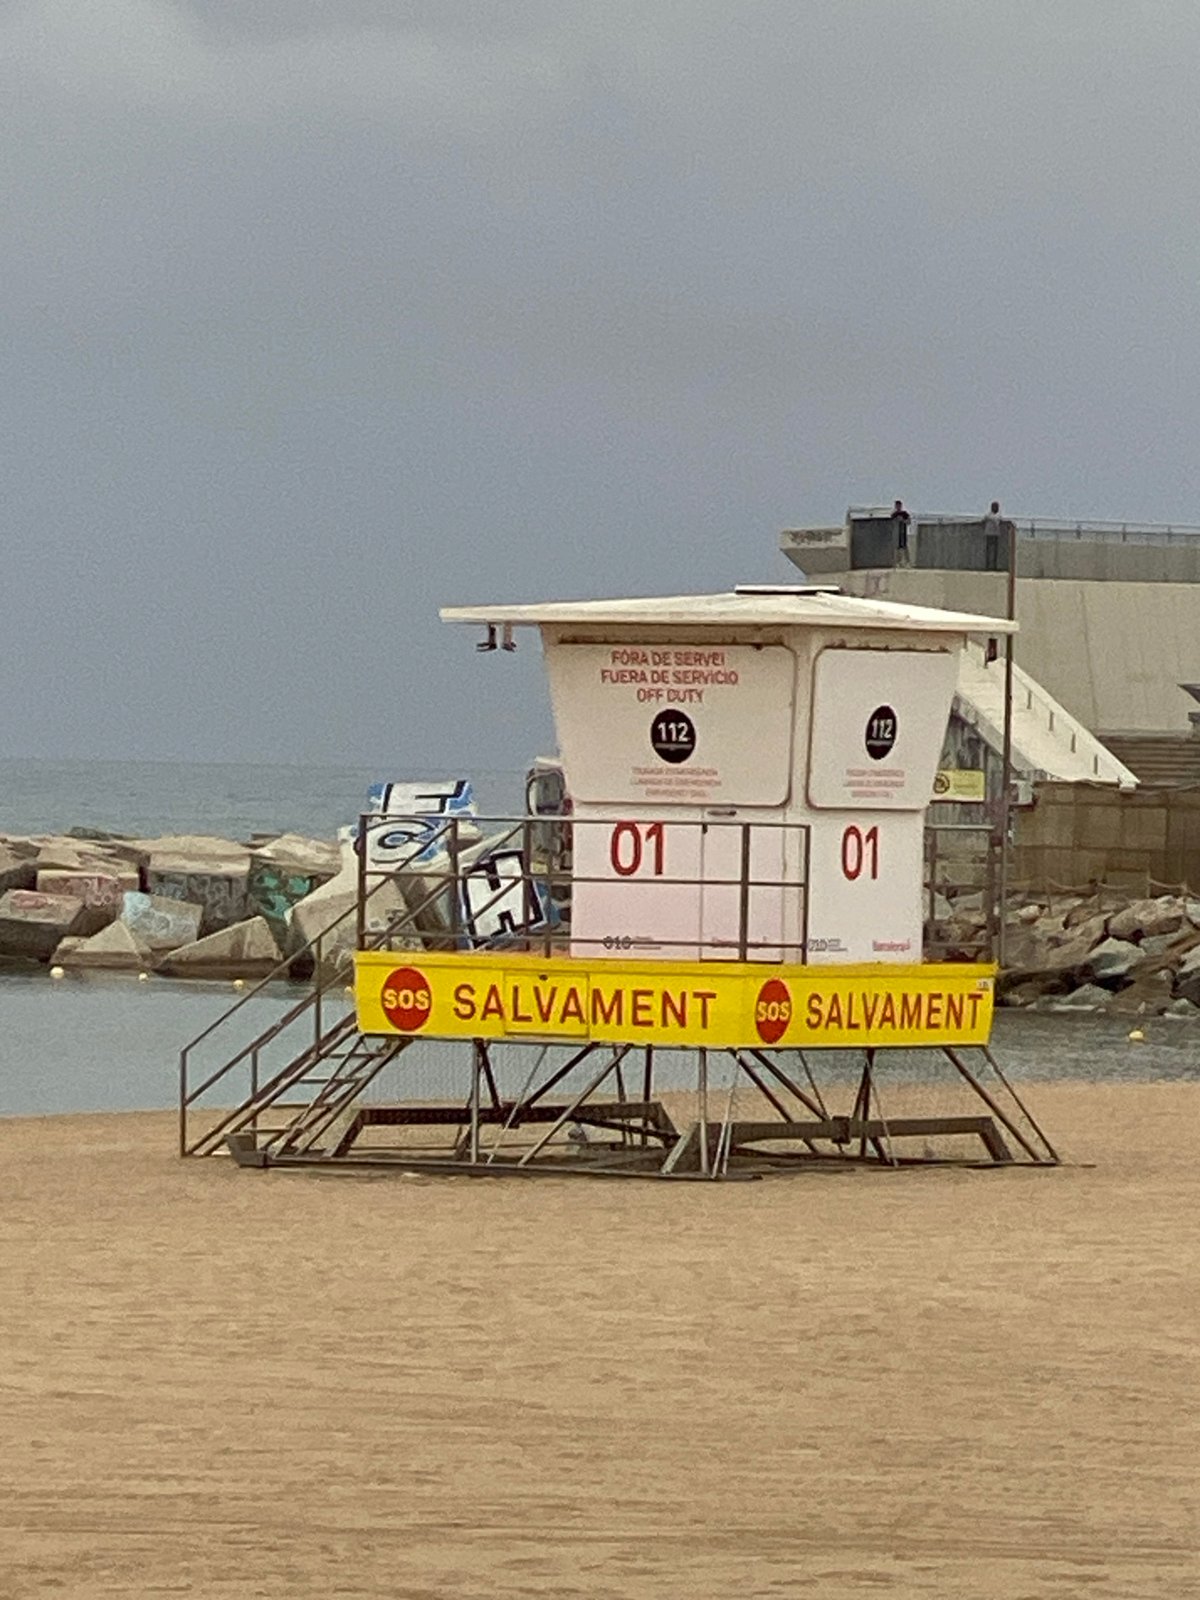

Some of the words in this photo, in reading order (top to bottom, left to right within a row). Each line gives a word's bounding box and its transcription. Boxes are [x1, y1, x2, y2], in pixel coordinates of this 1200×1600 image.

[652, 651, 672, 667] DE
[673, 652, 726, 667] SERVEI
[601, 668, 648, 684] FUERA
[651, 670, 671, 685] DE
[672, 670, 739, 686] SERVICIO
[636, 688, 664, 703] OFF
[666, 689, 704, 703] DUTY
[657, 722, 690, 742] 112
[871, 718, 893, 739] 112
[611, 820, 663, 876] 01
[841, 825, 879, 880] 01
[384, 988, 430, 1011] SOS
[453, 983, 717, 1029] SALVAMENT
[756, 1001, 790, 1023] SOS
[805, 992, 984, 1030] SALVAMENT
